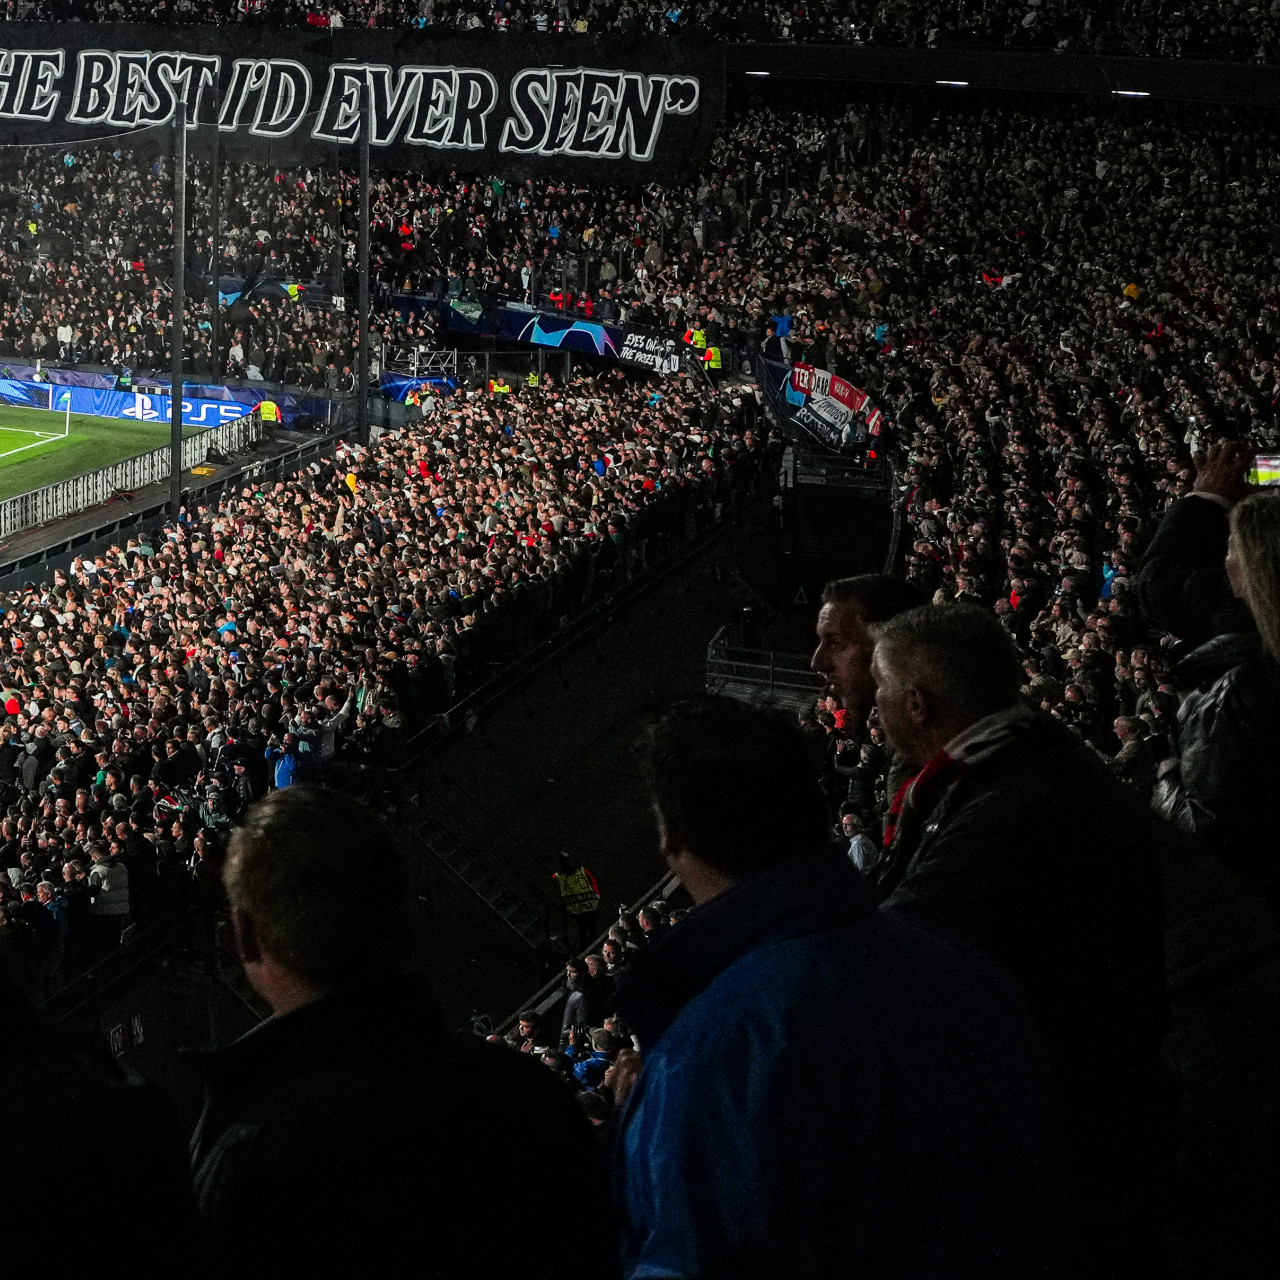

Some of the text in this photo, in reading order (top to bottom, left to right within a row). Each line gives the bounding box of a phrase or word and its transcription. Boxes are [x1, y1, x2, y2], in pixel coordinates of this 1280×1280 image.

[67, 50, 221, 129] BEST
[312, 64, 497, 151] EVER
[624, 334, 645, 347] EYES
[620, 347, 636, 360] THE
[167, 400, 243, 424] PS5
